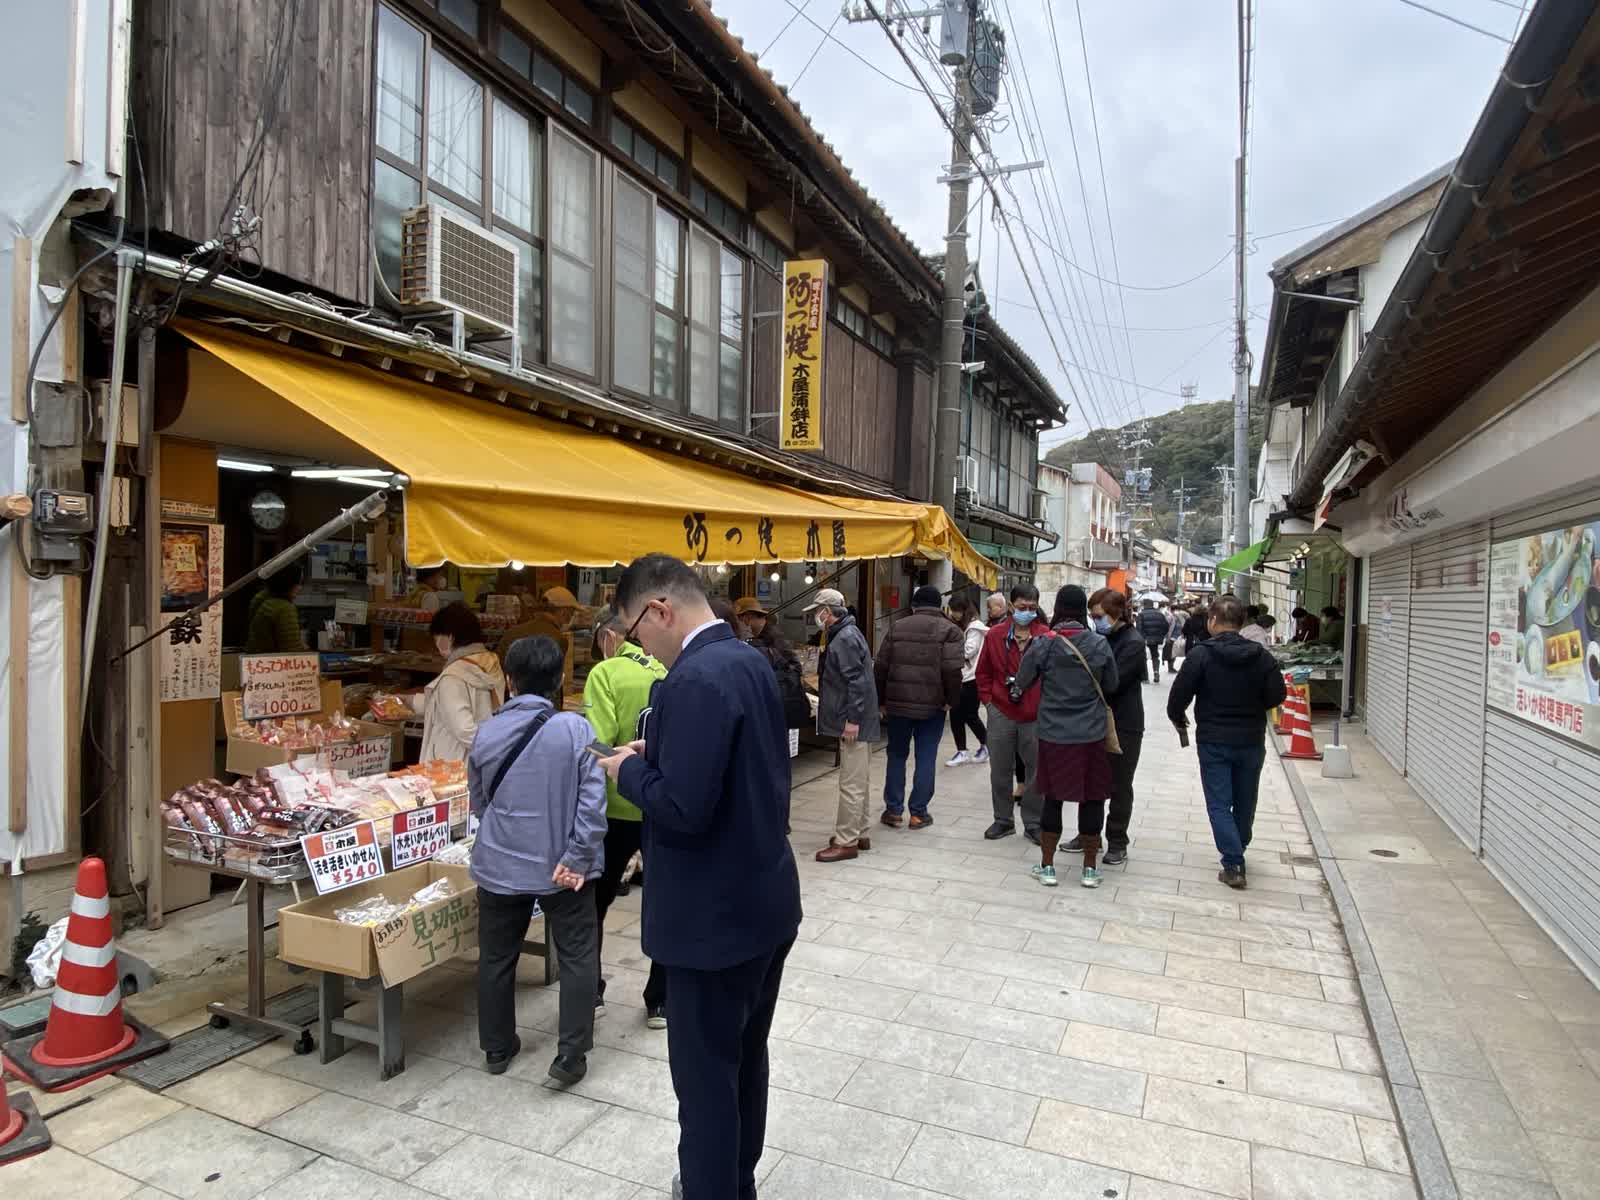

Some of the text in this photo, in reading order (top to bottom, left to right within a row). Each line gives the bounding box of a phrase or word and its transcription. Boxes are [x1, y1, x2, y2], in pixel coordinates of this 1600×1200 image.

[791, 363, 810, 439] 木屋蒲鉾店
[1516, 688, 1584, 733] 活いか料理専門店
[313, 847, 376, 876] 活き活きいかせん
[411, 838, 446, 859] ¥600
[332, 862, 377, 884] ¥540
[411, 896, 469, 947] 見切品
[417, 927, 475, 967] コーナー
